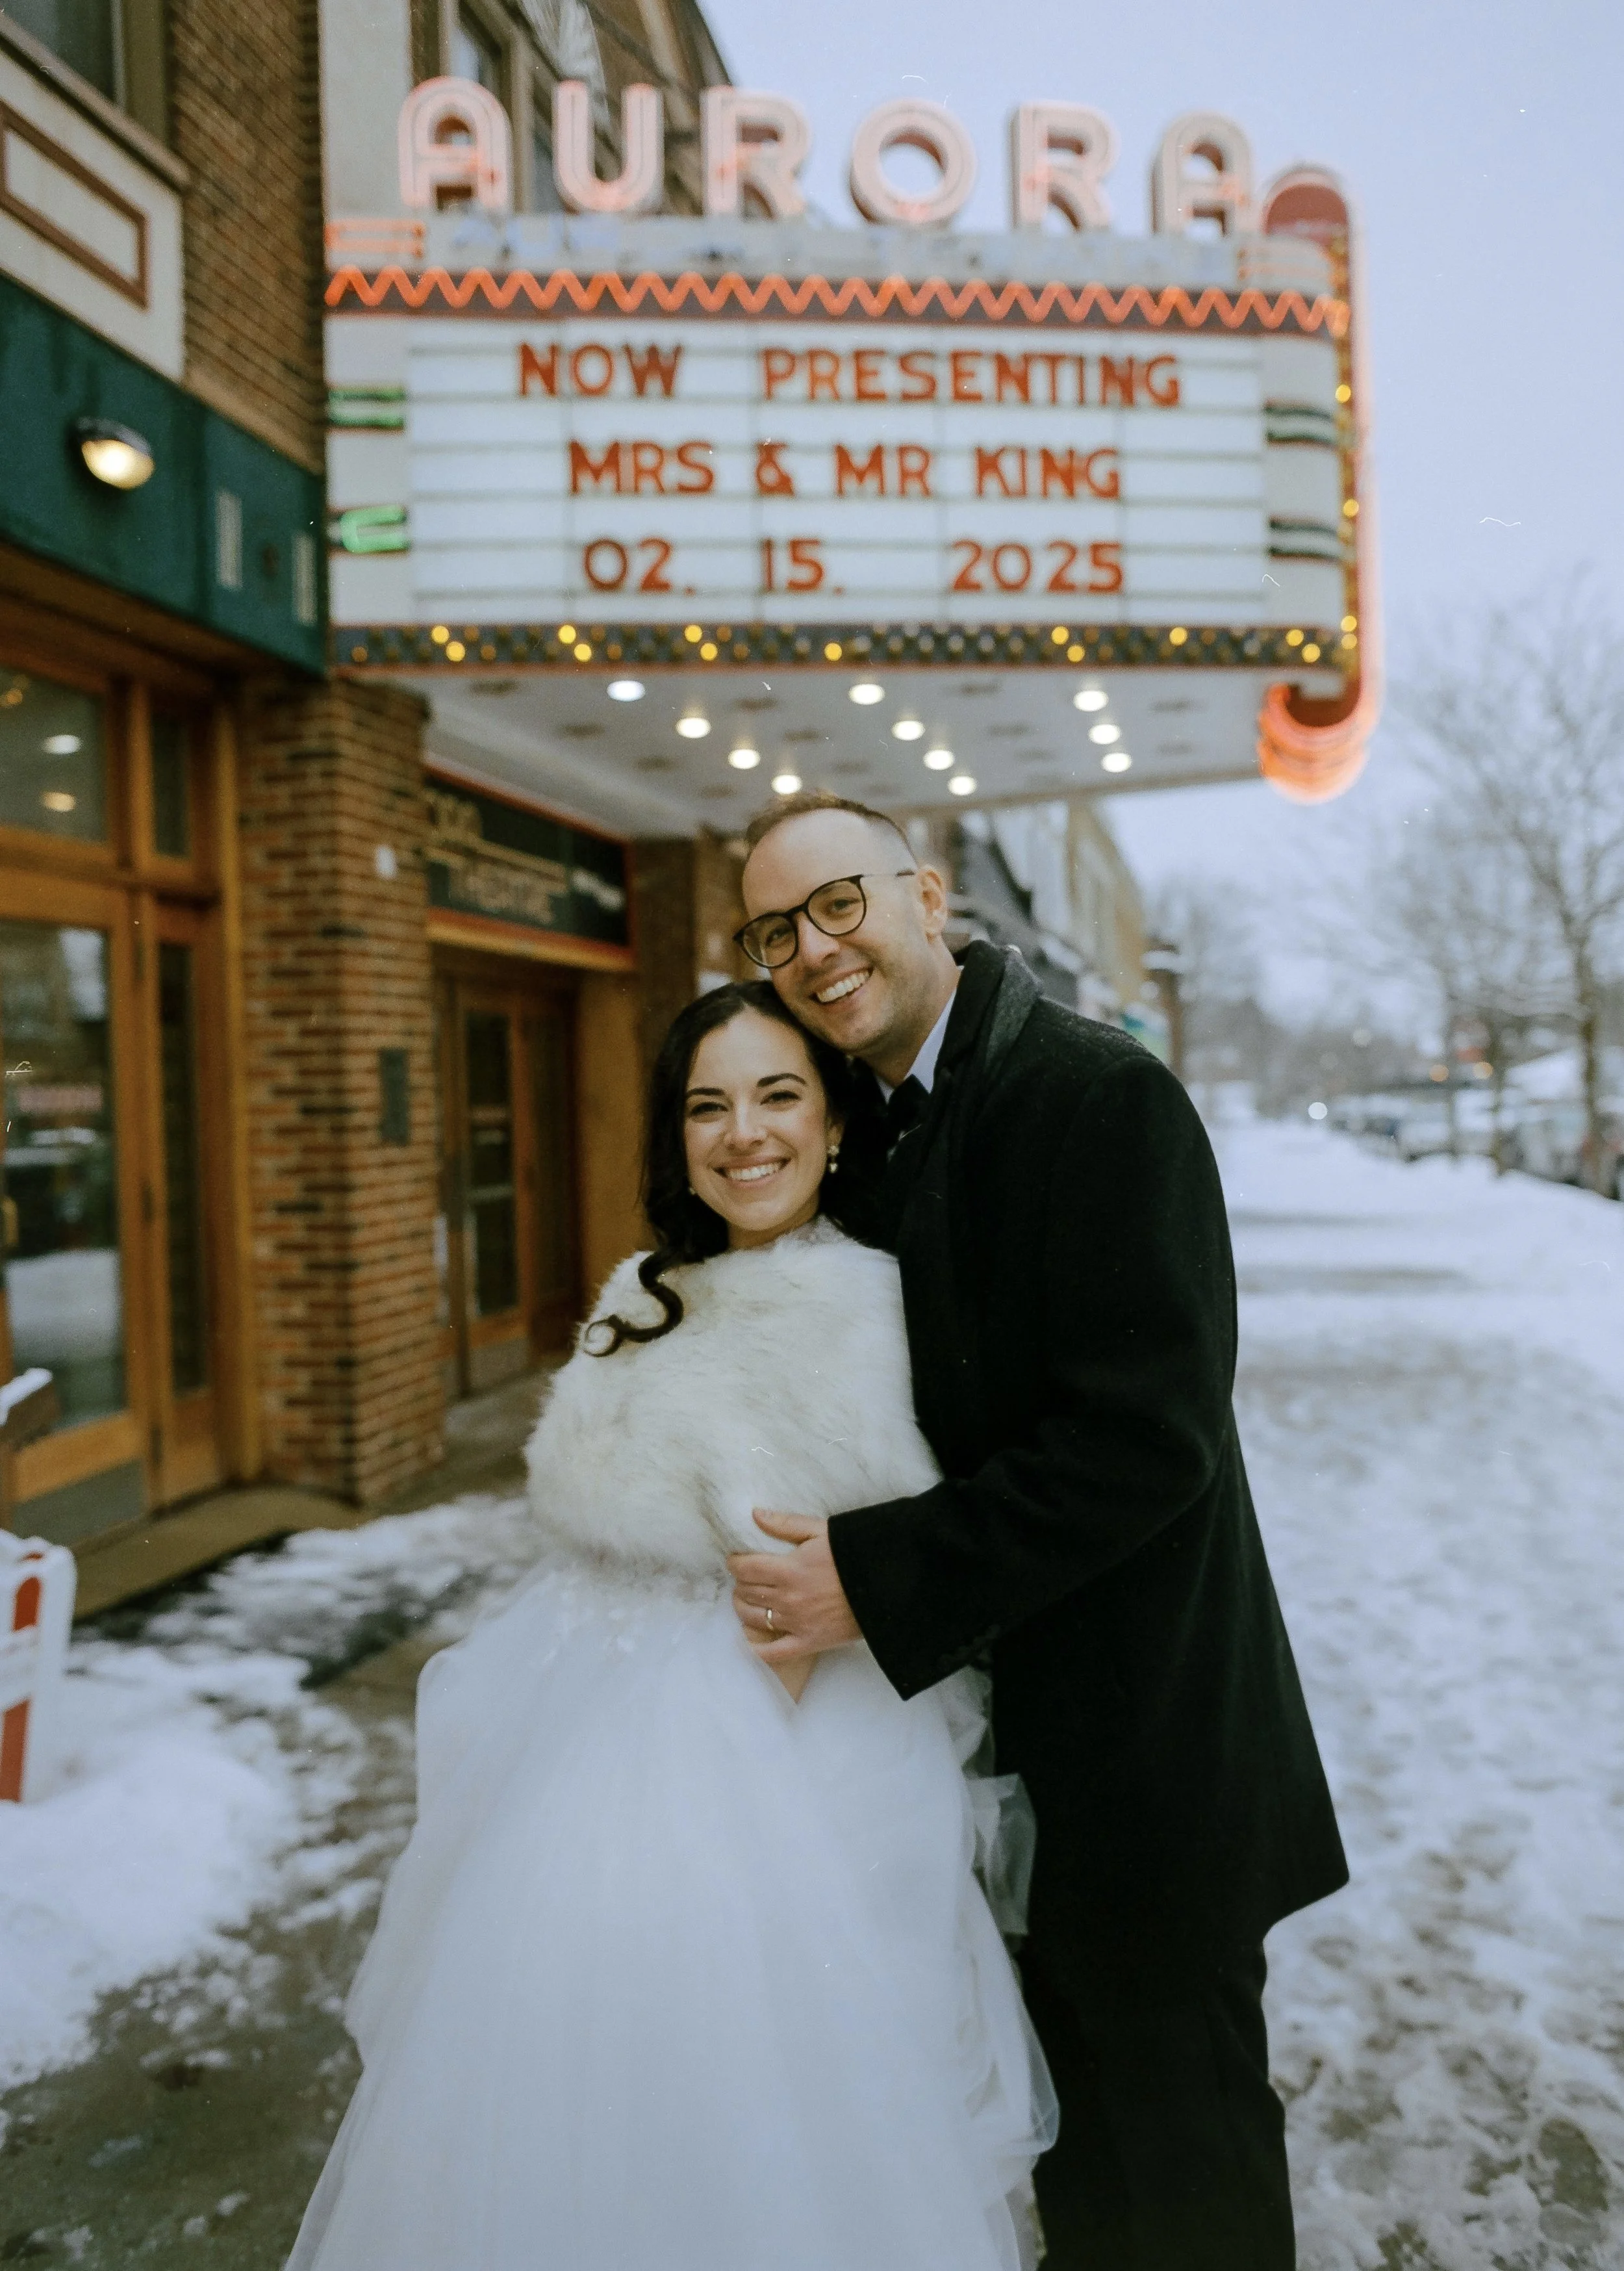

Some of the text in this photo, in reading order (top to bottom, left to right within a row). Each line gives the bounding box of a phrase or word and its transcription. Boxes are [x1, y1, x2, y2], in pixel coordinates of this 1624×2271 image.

[398, 77, 1254, 234] AURORA
[515, 341, 1182, 409] NOW PRESENTING
[567, 439, 1121, 502] MRS & MR KING
[583, 537, 1126, 597] 02. 15. 2025
